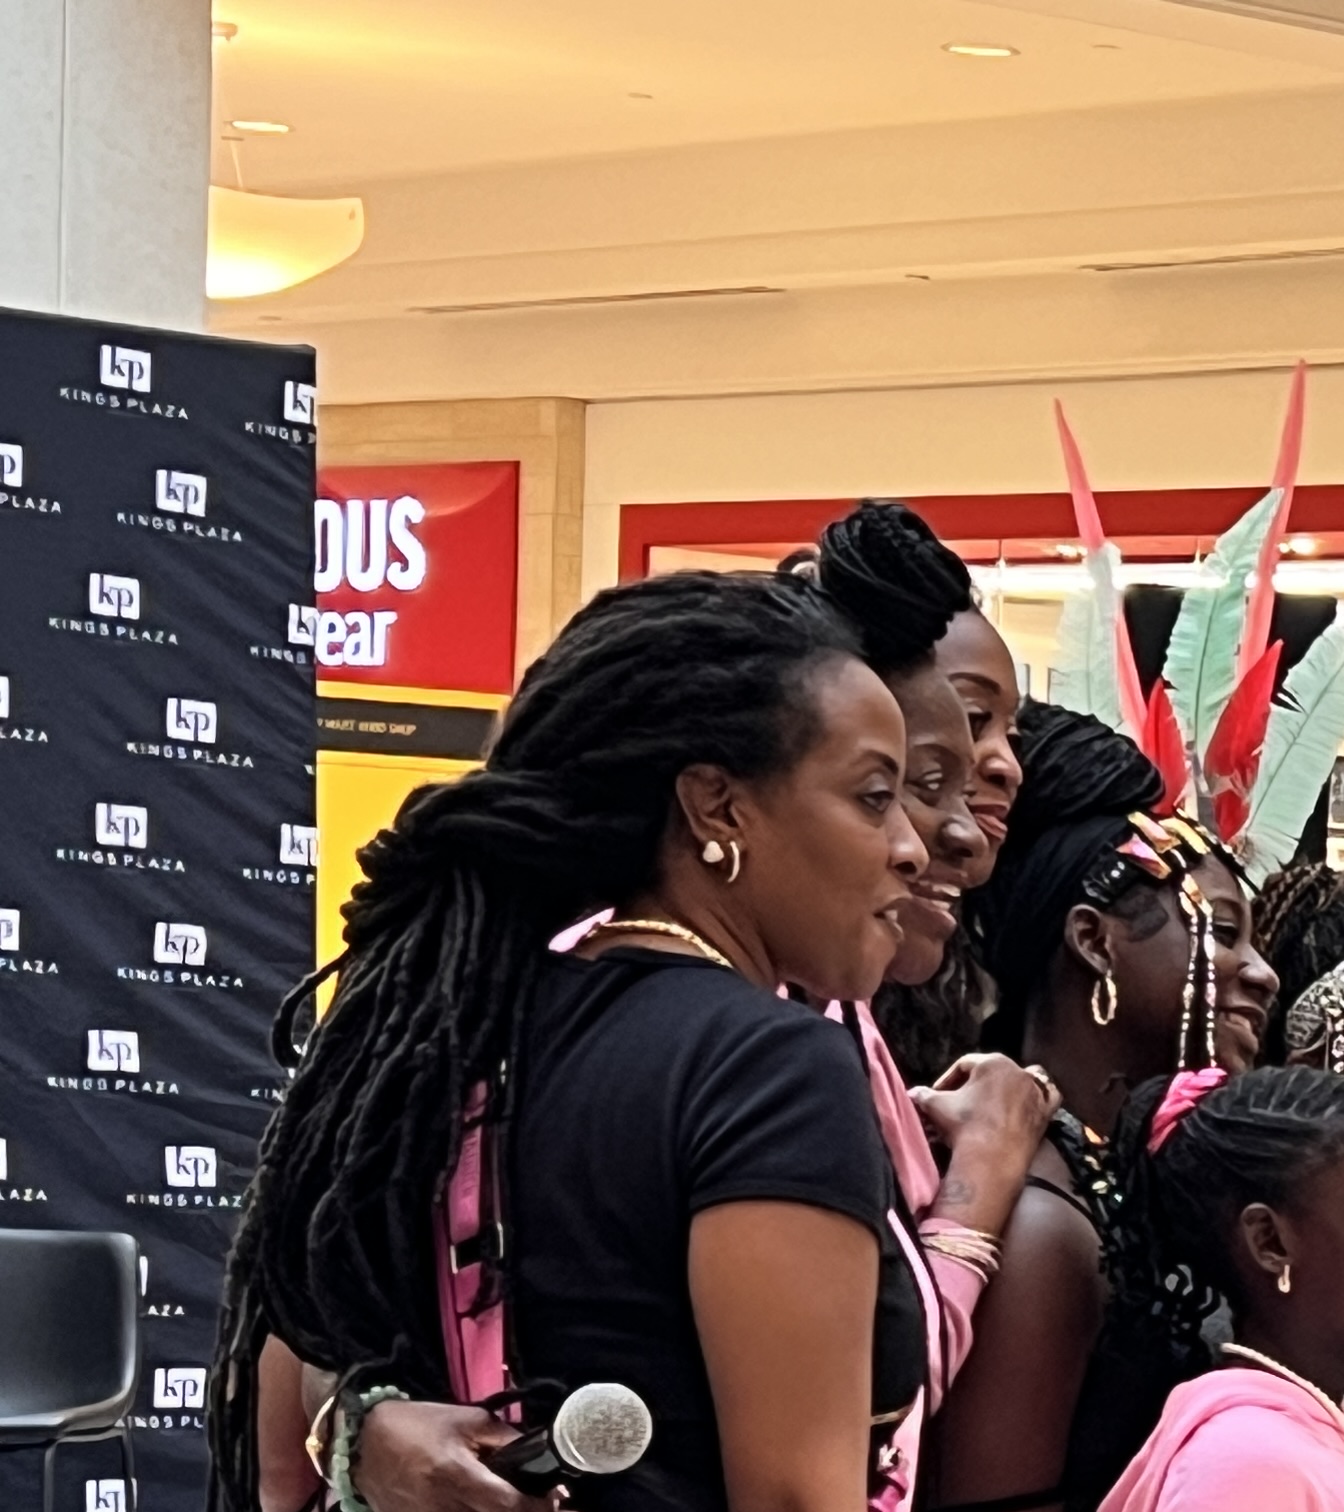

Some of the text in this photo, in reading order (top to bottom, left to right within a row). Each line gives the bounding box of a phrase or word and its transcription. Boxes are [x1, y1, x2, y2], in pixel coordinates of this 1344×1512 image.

[60, 387, 189, 420] KINGS PLAZA
[182, 521, 242, 542] PLAZA
[314, 495, 427, 593] OUS
[116, 625, 178, 646] PLAZA
[315, 611, 398, 667] ear
[193, 749, 254, 768] PLAZA
[124, 853, 185, 873] PLAZA
[180, 972, 243, 988] PLAZA
[115, 1079, 179, 1095] PLAZA
[194, 1194, 243, 1208] PLAZ
